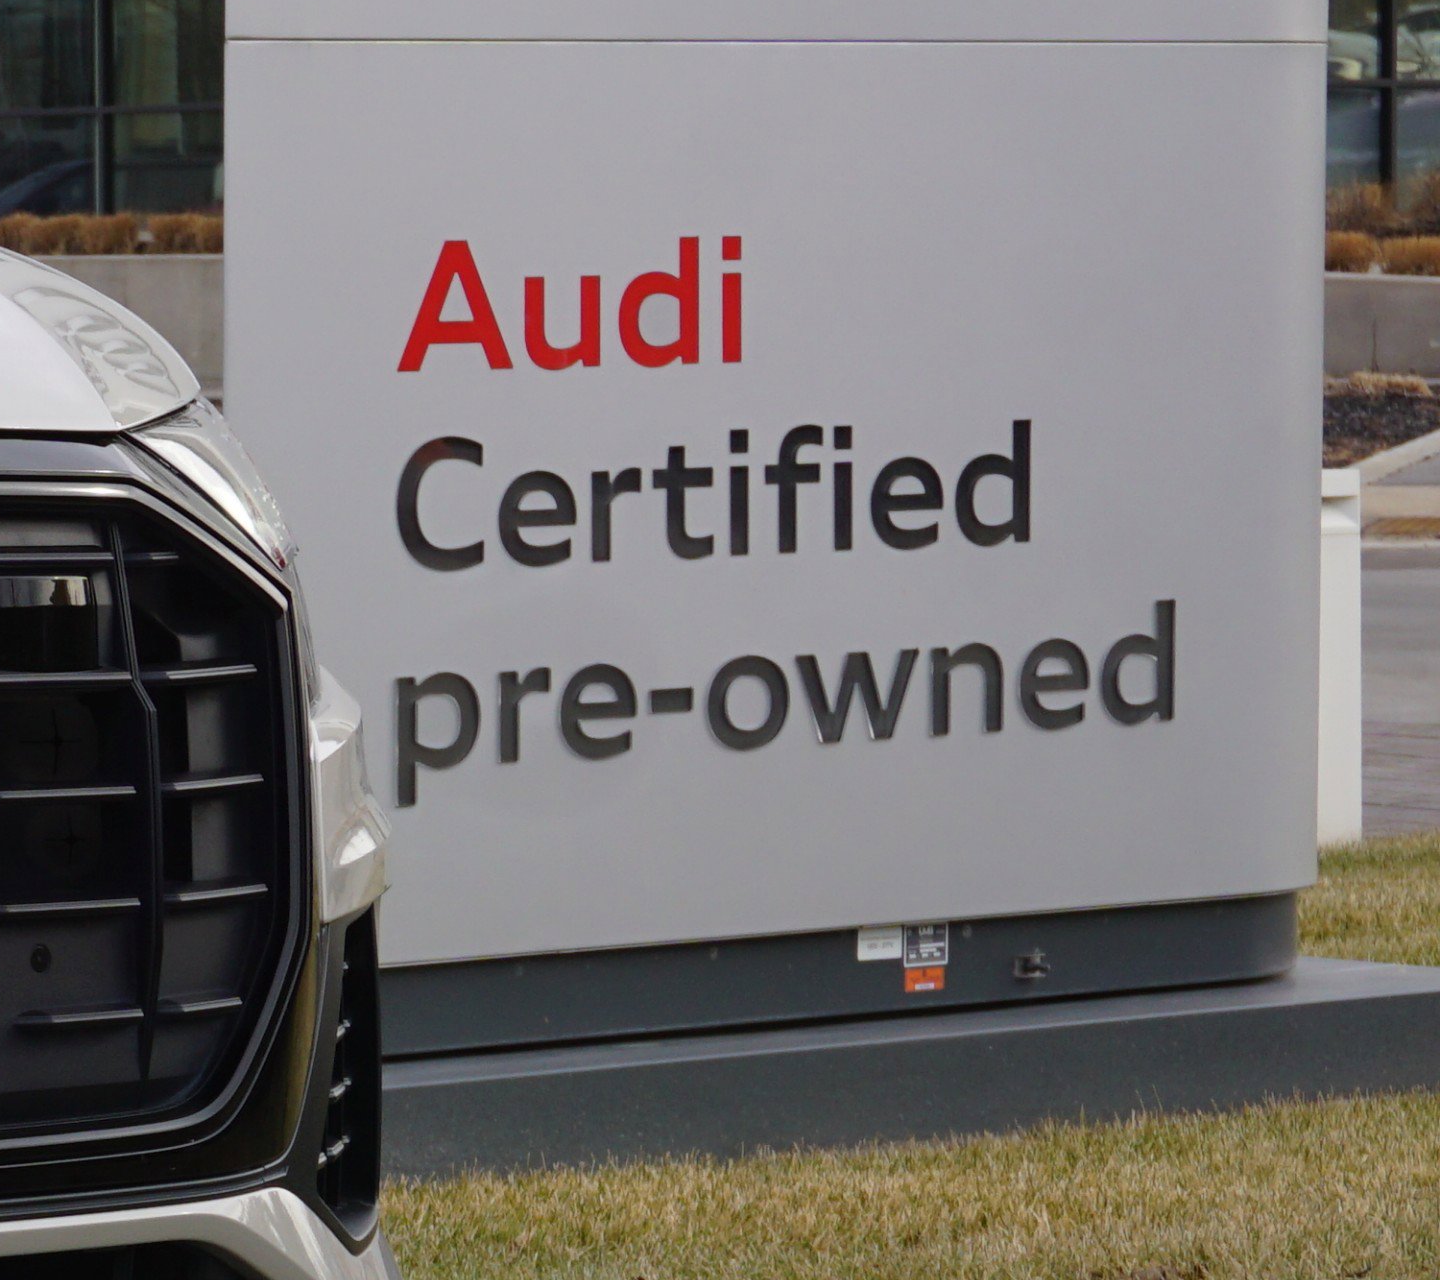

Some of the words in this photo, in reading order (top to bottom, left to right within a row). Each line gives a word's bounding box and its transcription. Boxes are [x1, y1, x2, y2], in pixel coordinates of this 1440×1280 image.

[397, 236, 743, 373] Audi
[395, 419, 1032, 573] Certified
[395, 599, 1177, 809] pre-owned
